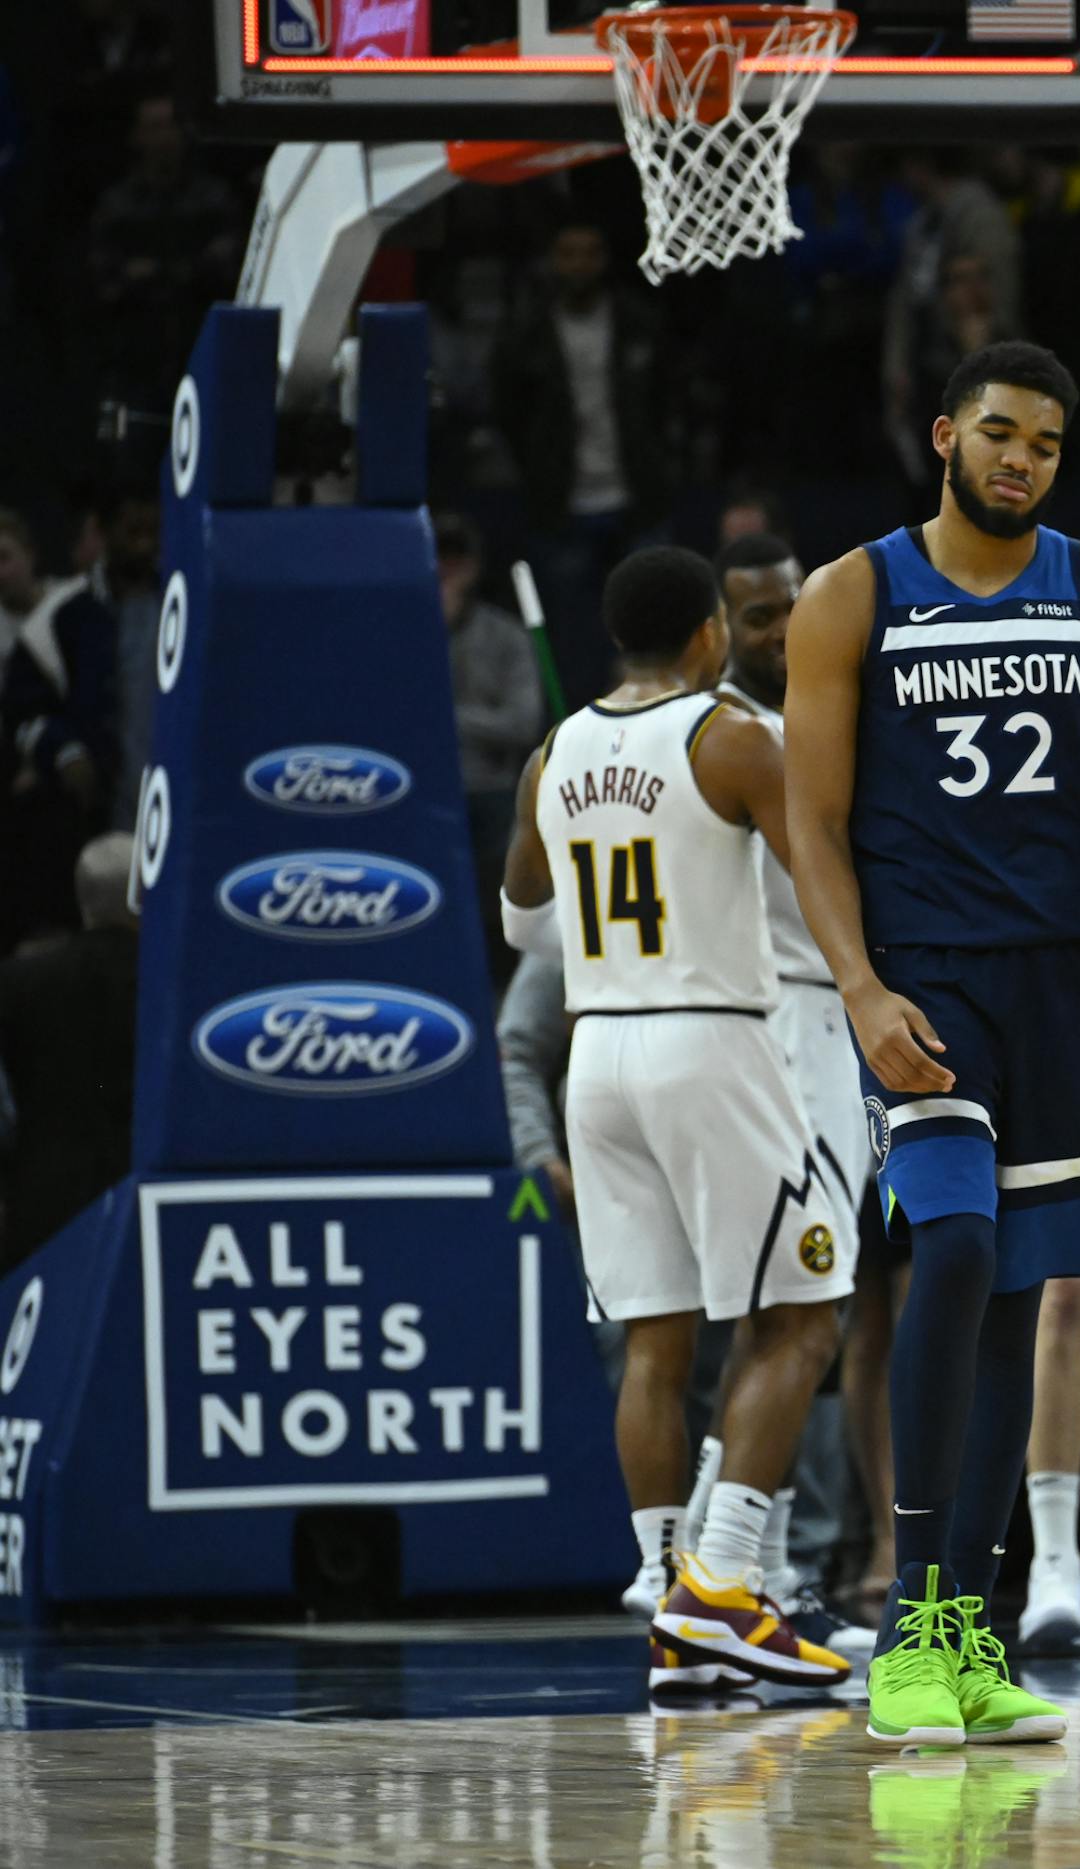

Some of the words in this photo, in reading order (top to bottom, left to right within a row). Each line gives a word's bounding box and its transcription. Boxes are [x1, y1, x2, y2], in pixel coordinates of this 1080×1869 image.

[1037, 603, 1073, 617] fitbit
[273, 752, 382, 802] Ford
[935, 711, 1056, 798] 32
[559, 766, 665, 819] HARRIS
[258, 861, 399, 926] Ford
[568, 836, 667, 960] 14
[246, 1000, 423, 1075] Ford
[192, 1220, 363, 1290] ALL
[197, 1302, 427, 1374] EYES
[0, 1416, 42, 1500] ET
[200, 1387, 541, 1459] NORTH
